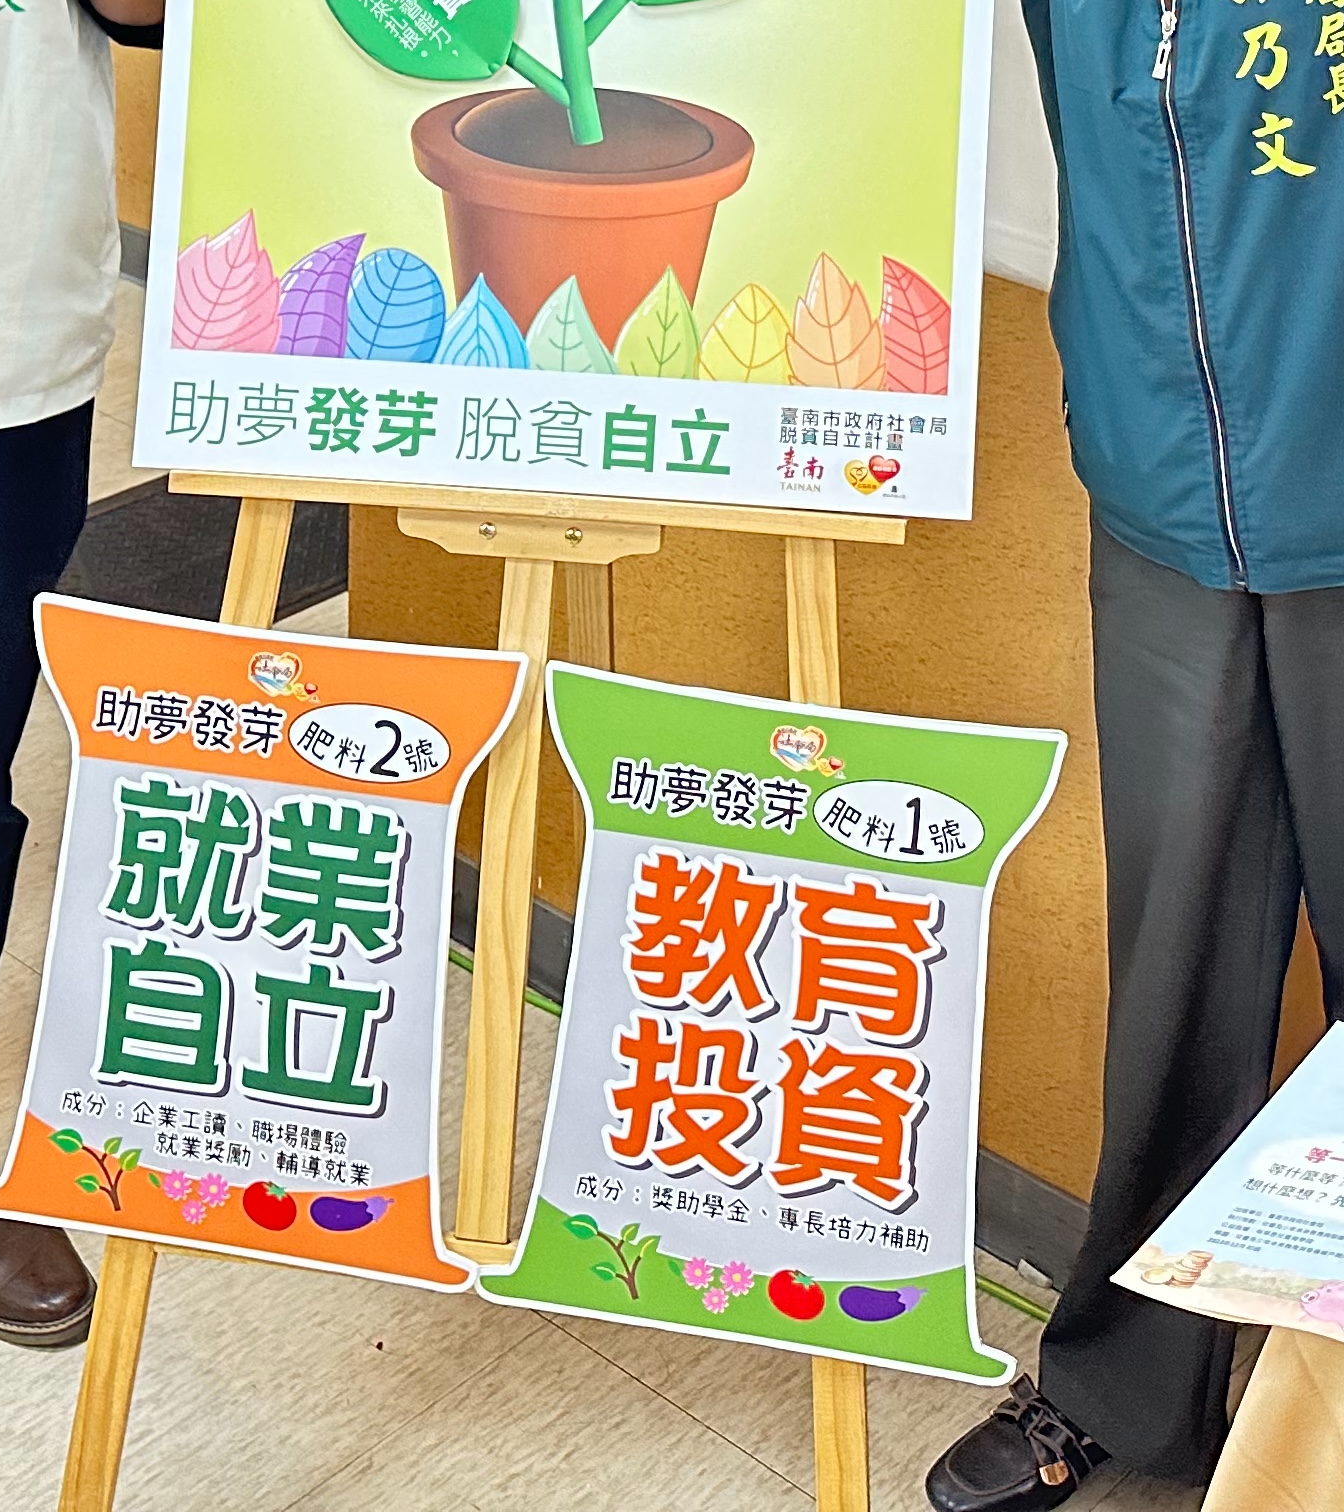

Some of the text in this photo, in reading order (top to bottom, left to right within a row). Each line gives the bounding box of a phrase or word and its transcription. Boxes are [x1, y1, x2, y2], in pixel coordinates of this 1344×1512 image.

[165, 380, 731, 476] 助夢發芽 脫貧自立
[776, 446, 824, 481] 臺南
[779, 426, 904, 451] 脫貧自立計畫
[780, 407, 947, 435] 臺南市政府社會局
[779, 481, 821, 493] TAINAN
[96, 691, 438, 778] 助夢發芽 肥料2號
[610, 761, 966, 856] 助夢發芽 肥料1號
[106, 778, 400, 953] 就業
[628, 854, 932, 1036] 教育
[100, 938, 383, 1106] 自立
[609, 1016, 916, 1202] 投資
